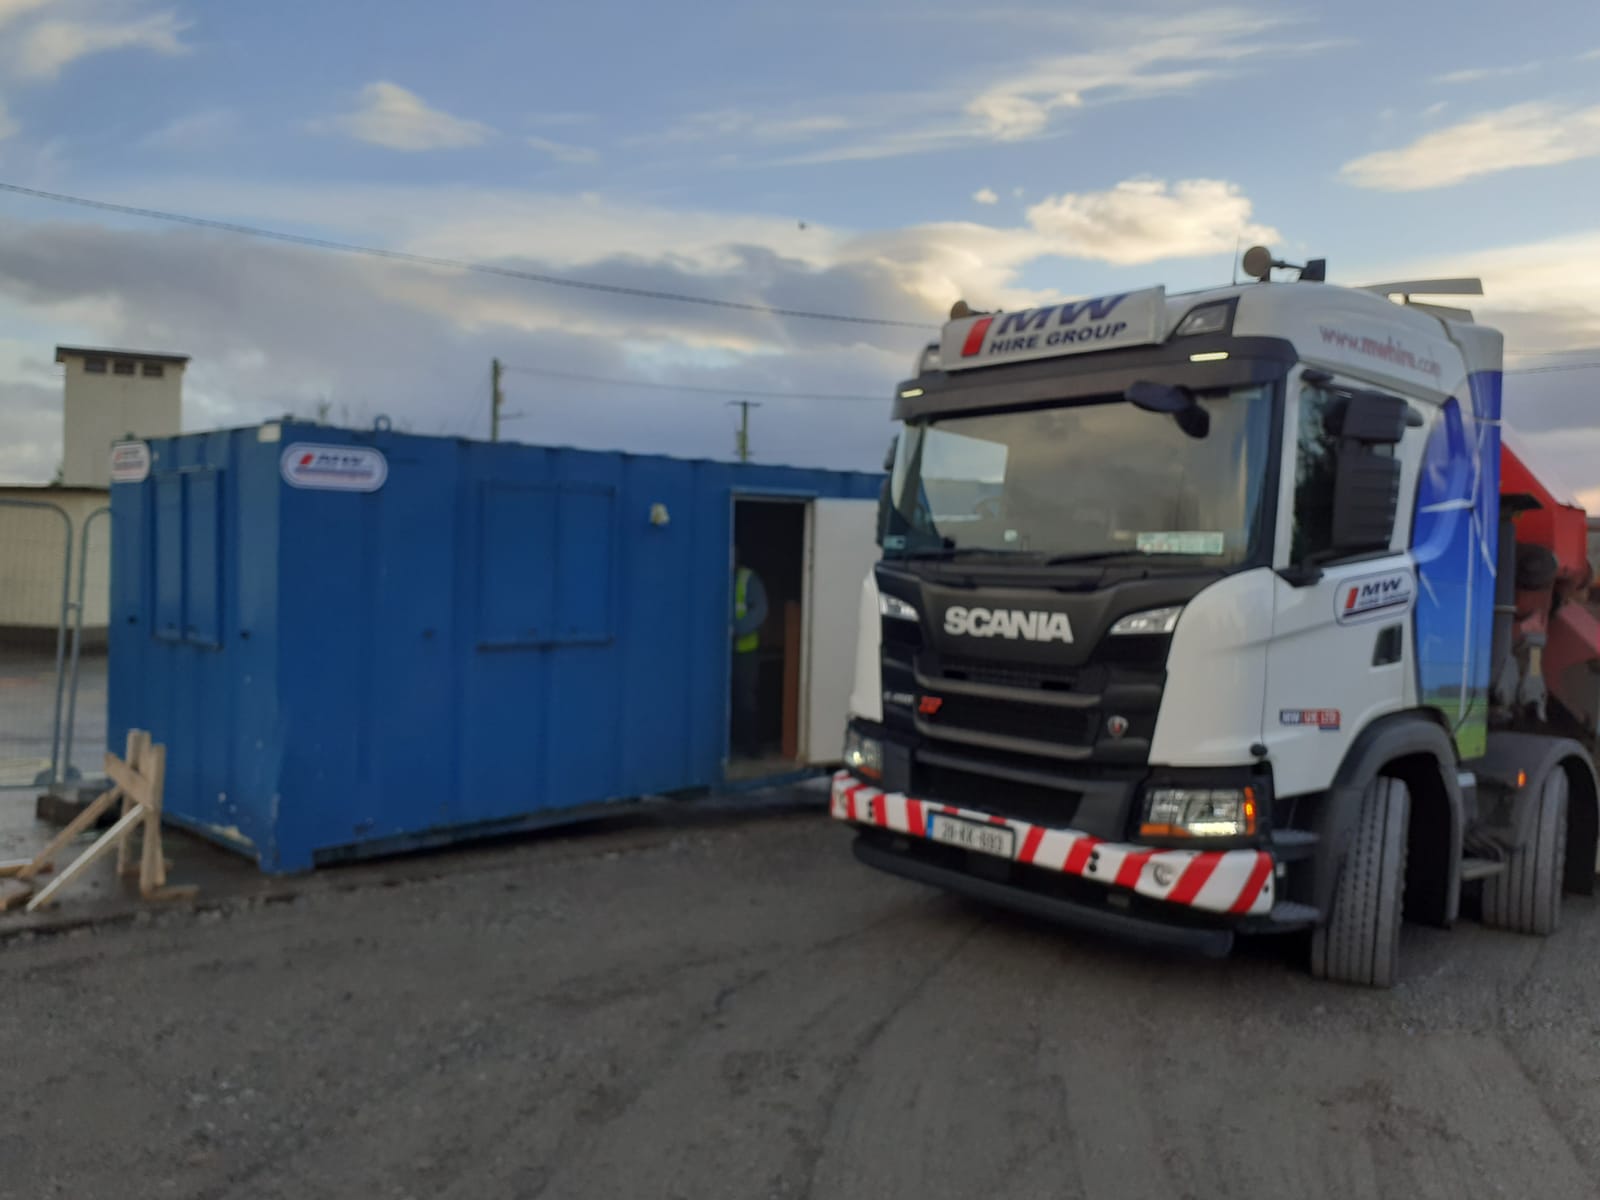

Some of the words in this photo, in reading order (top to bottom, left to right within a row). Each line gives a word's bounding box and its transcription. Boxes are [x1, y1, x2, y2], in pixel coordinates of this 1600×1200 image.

[997, 294, 1129, 335] MW
[988, 333, 1039, 354] HIRE
[1046, 322, 1127, 346] GROUP
[1361, 577, 1402, 597] MW
[943, 605, 1074, 644] SCANIA
